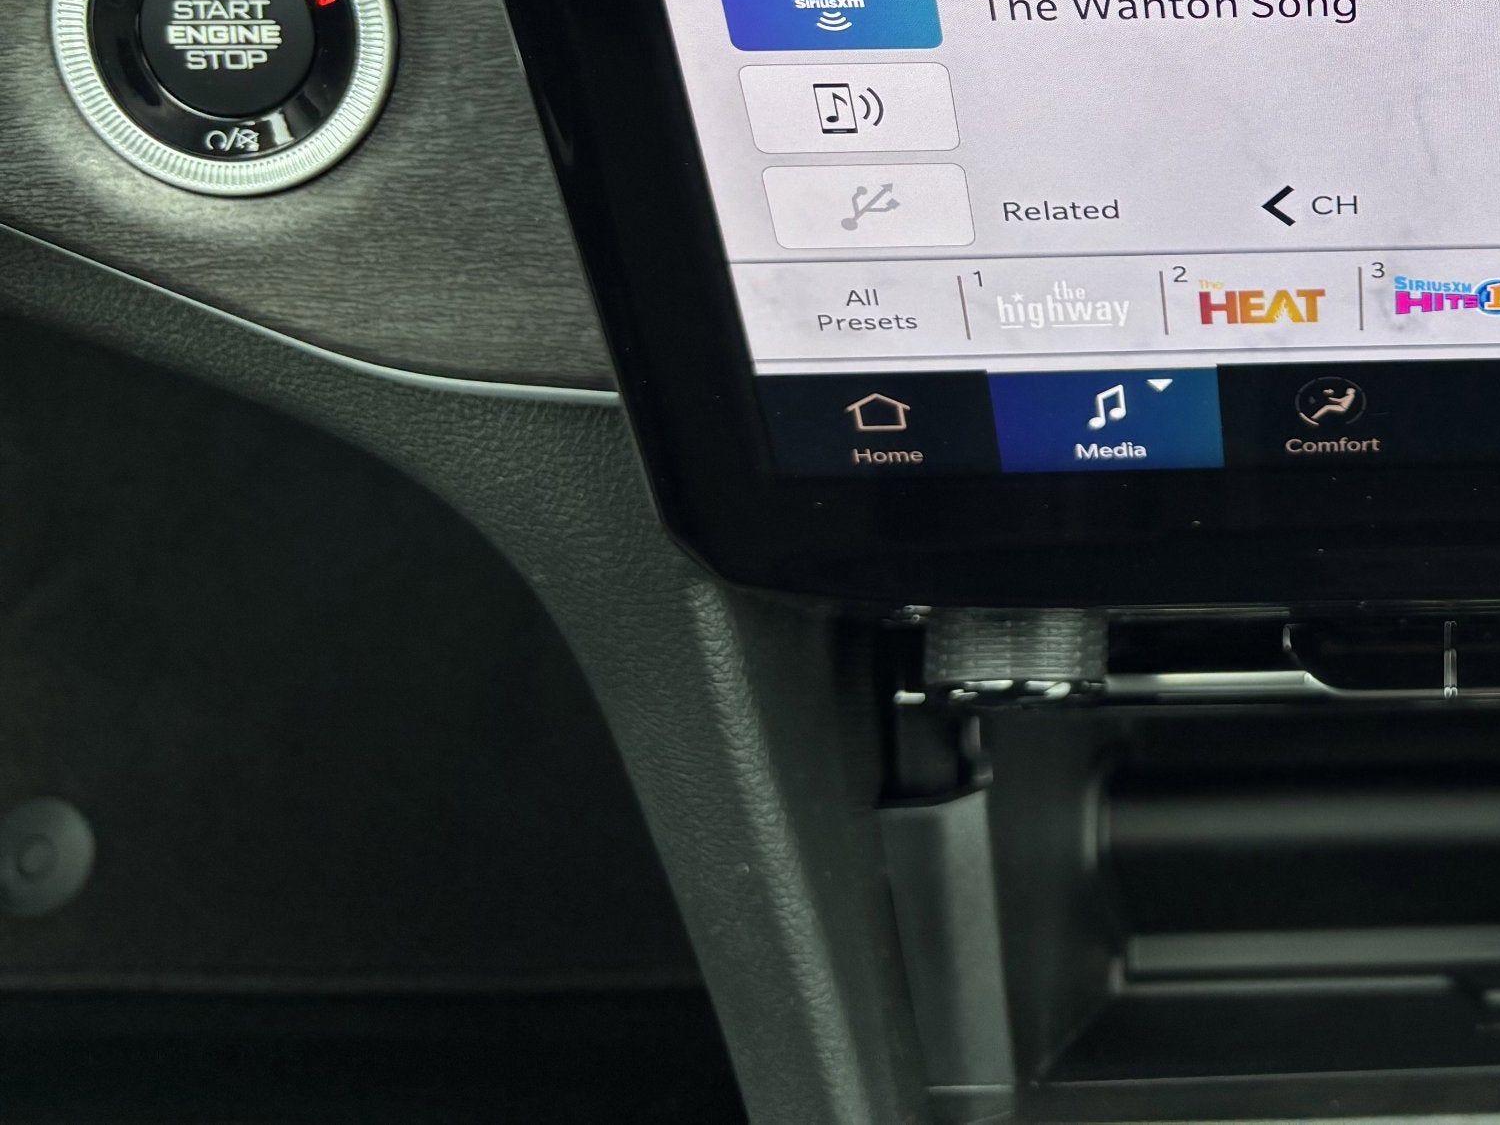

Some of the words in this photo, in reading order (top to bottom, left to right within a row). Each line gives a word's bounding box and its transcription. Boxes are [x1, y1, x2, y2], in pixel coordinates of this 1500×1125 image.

[172, 0, 272, 21] START
[166, 24, 283, 46] ENGINE
[184, 48, 269, 71] STOP
[1002, 199, 1121, 222] Related
[1310, 194, 1359, 216] CH
[972, 270, 984, 288] 1
[1172, 265, 1189, 285] 2
[1370, 261, 1387, 280] 3
[845, 288, 880, 308] All
[1053, 280, 1086, 301] the
[996, 291, 1131, 330] highway
[1198, 288, 1327, 326] HEAT
[1395, 290, 1480, 316] HITS
[816, 312, 919, 333] Presets
[853, 446, 925, 465] Home
[1074, 441, 1148, 461] Media
[1285, 437, 1381, 454] Comfort
